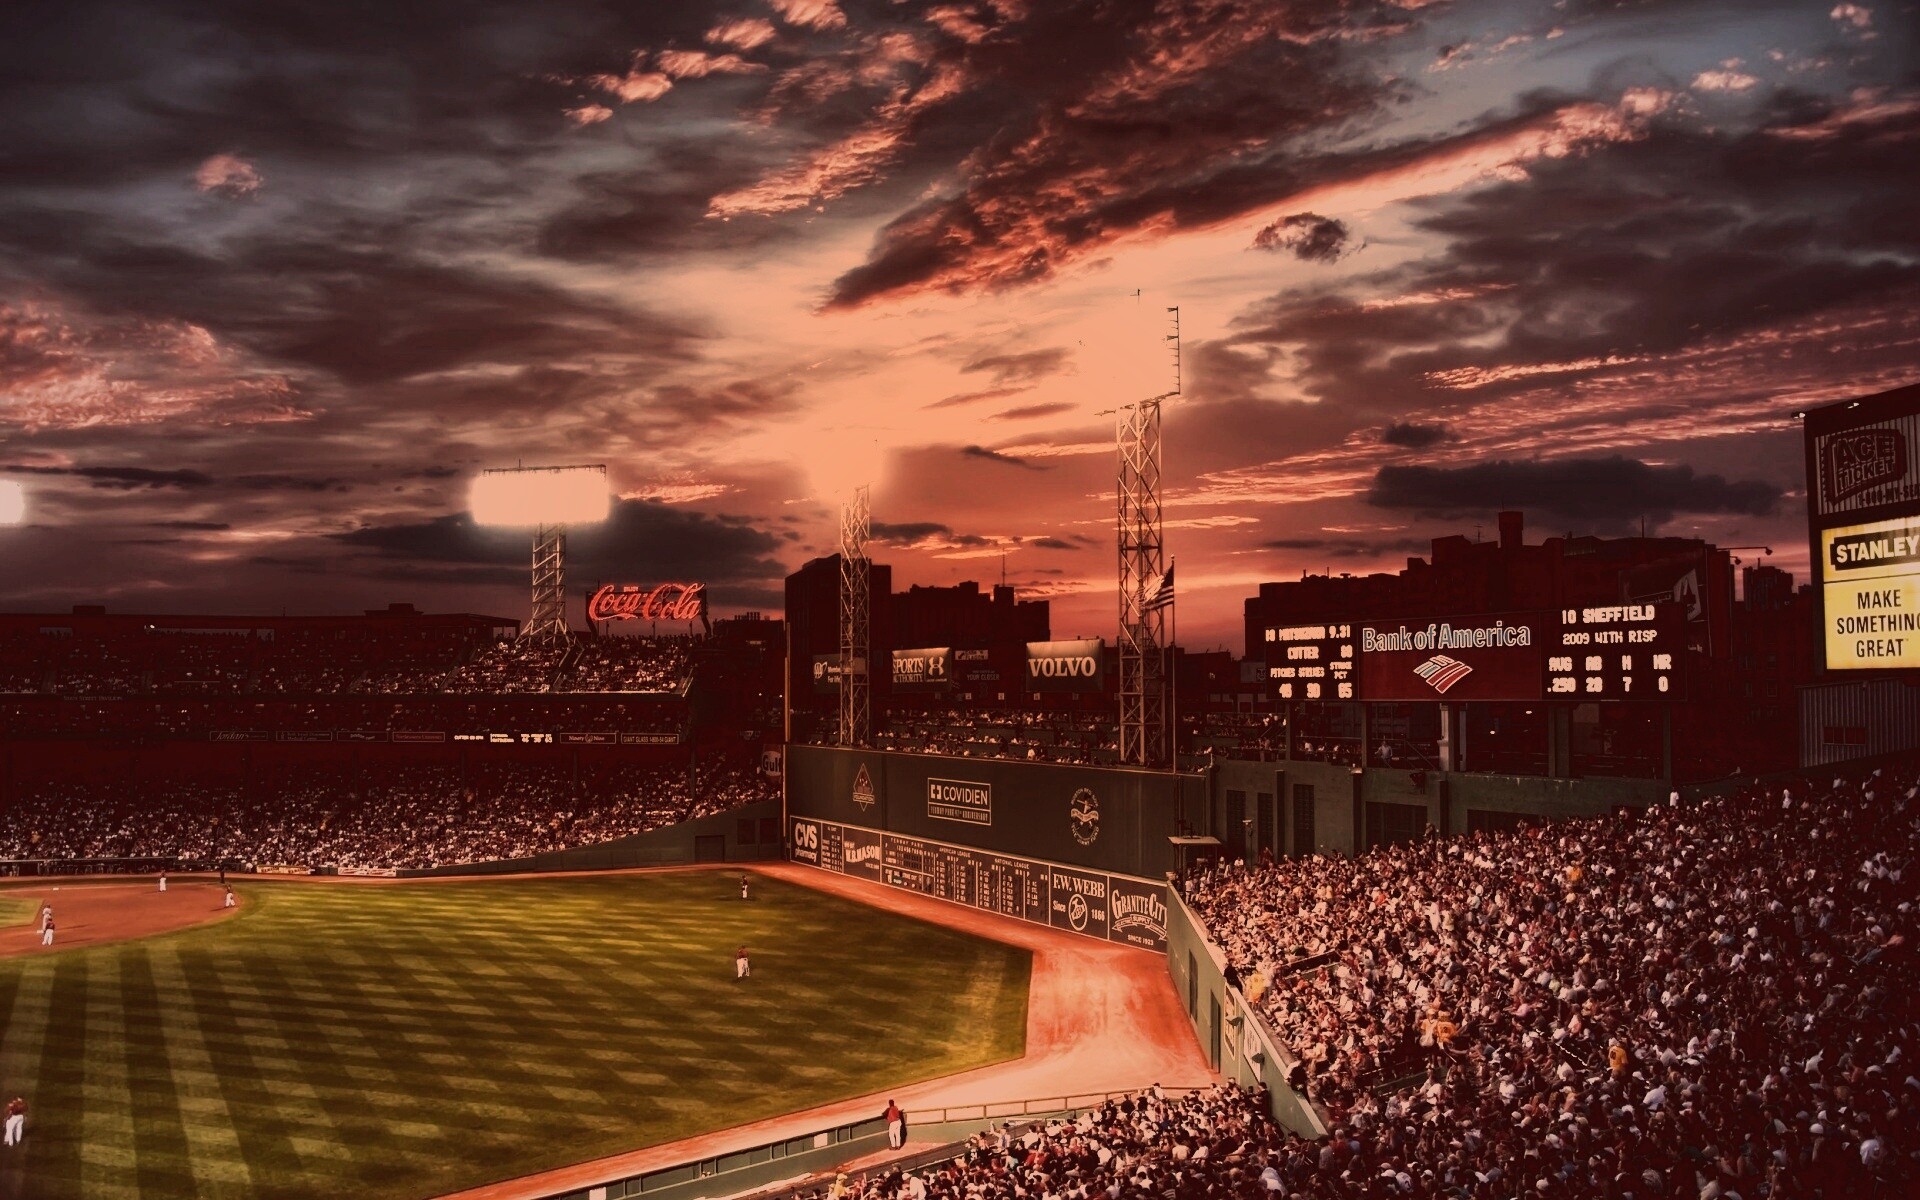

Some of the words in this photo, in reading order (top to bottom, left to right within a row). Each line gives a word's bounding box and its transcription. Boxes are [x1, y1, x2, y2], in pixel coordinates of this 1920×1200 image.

[1836, 434, 1896, 466] ACE
[1836, 535, 1920, 563] STANLEY
[588, 583, 706, 621] Coca-Cola
[1857, 589, 1902, 609] MAKE
[1562, 609, 1576, 624] 10
[1582, 605, 1655, 623] SHEFFIELD
[1362, 625, 1412, 652] Bank
[1414, 623, 1437, 650] of
[1437, 620, 1531, 650] America
[1562, 632, 1590, 645] 2009
[1594, 631, 1624, 644] WITH
[1628, 629, 1658, 643] RISP
[1856, 638, 1904, 657] GREAT
[893, 657, 924, 674] SPORTS
[1028, 656, 1096, 678] VOLVO
[1621, 655, 1632, 671] H
[1653, 654, 1672, 670] HR
[1622, 676, 1632, 692] 7
[1658, 676, 1668, 692] 0
[943, 786, 988, 805] COVIDIEN
[795, 822, 818, 849] CVS
[795, 847, 818, 863] pharmacy
[1073, 877, 1105, 898] WEBB
[1053, 900, 1066, 913] Since
[1112, 889, 1149, 919] GRANITE
[1127, 934, 1142, 943] SINCE
